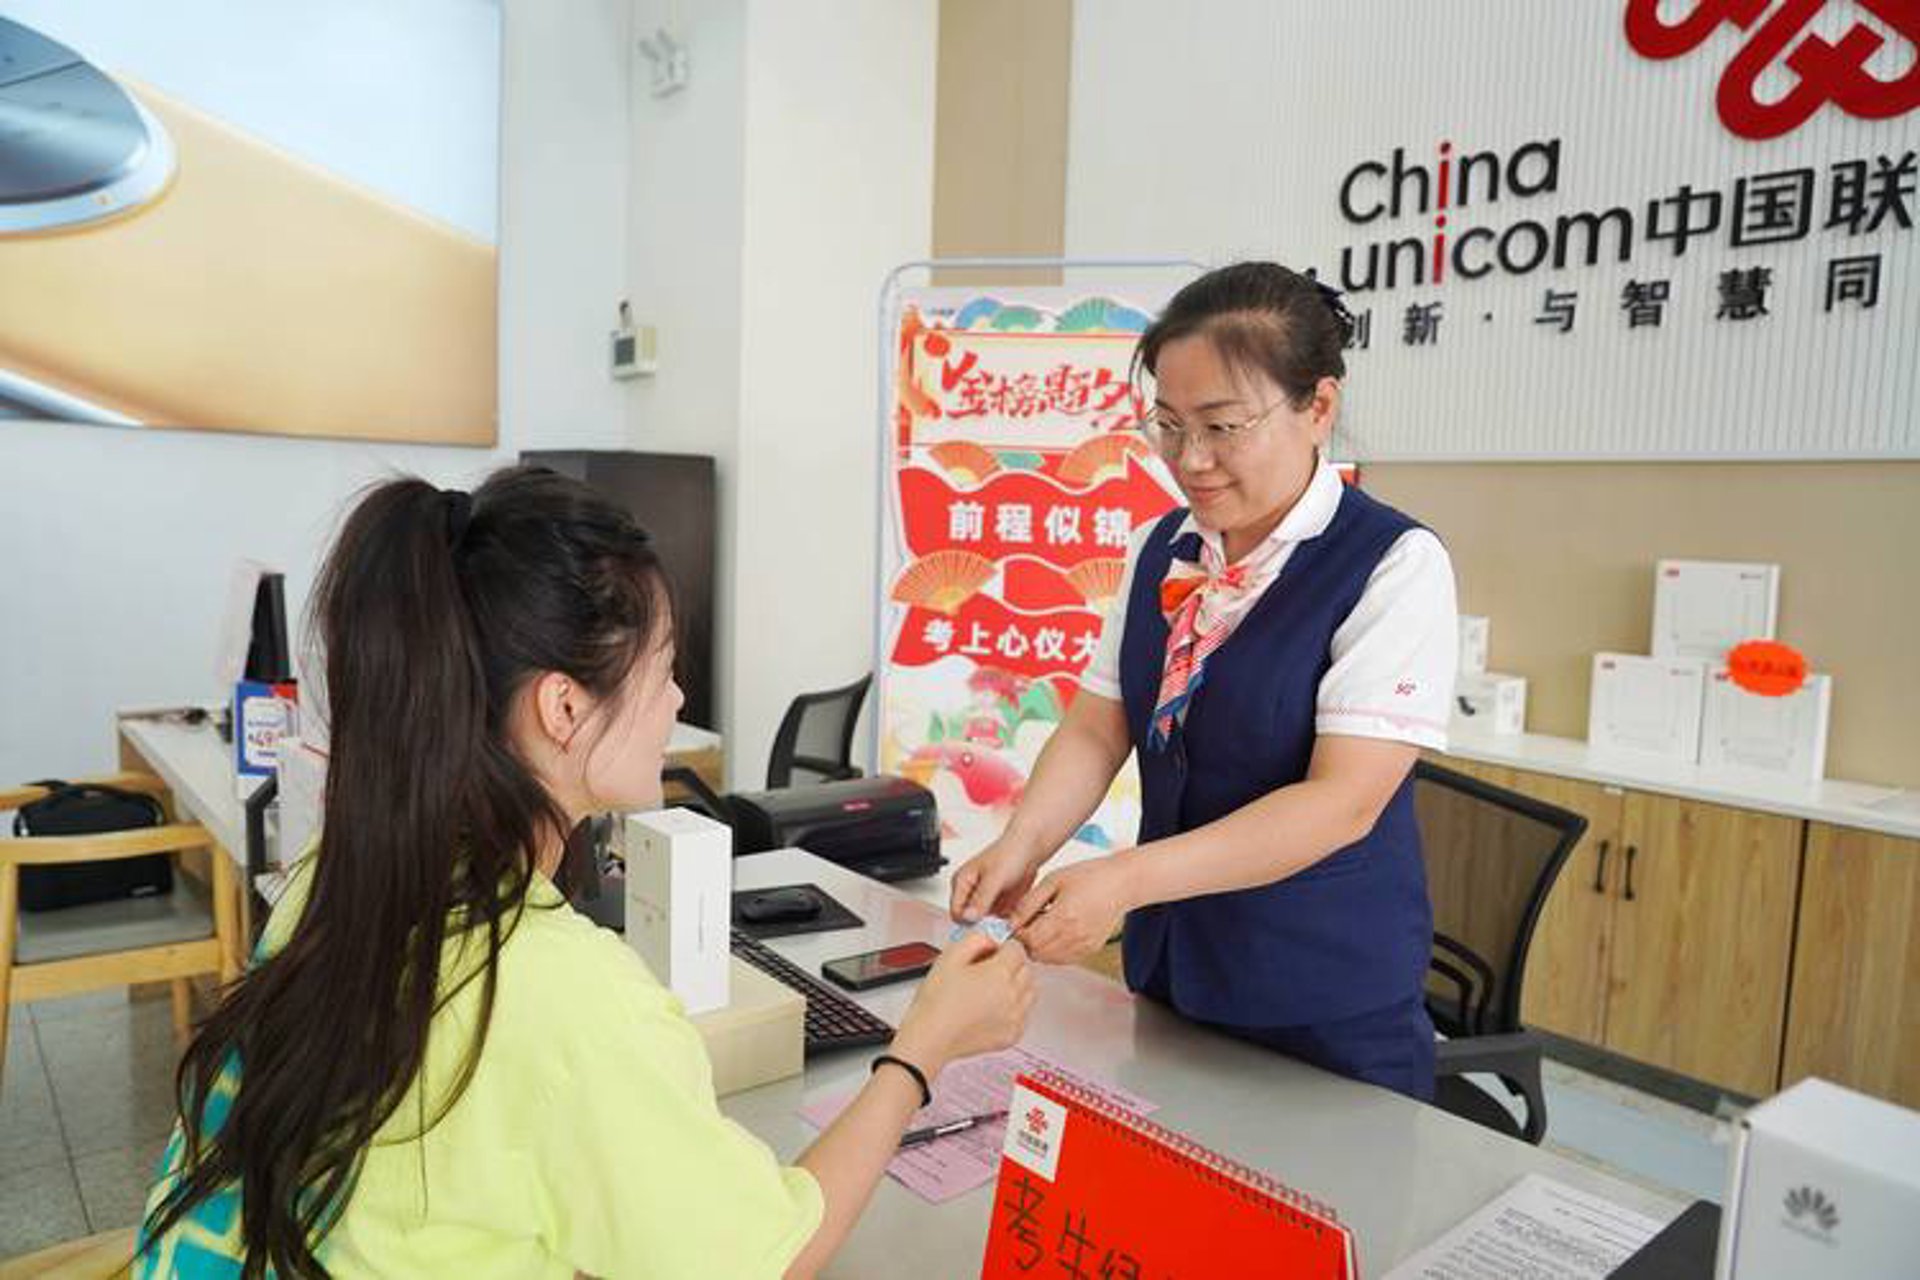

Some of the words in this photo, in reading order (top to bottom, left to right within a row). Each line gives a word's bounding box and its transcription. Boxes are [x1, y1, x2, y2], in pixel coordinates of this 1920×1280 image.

[1340, 139, 1561, 225] China
[1645, 151, 1918, 257] 中国联
[1341, 206, 1633, 292] unicom
[948, 501, 1132, 547] 前程似锦
